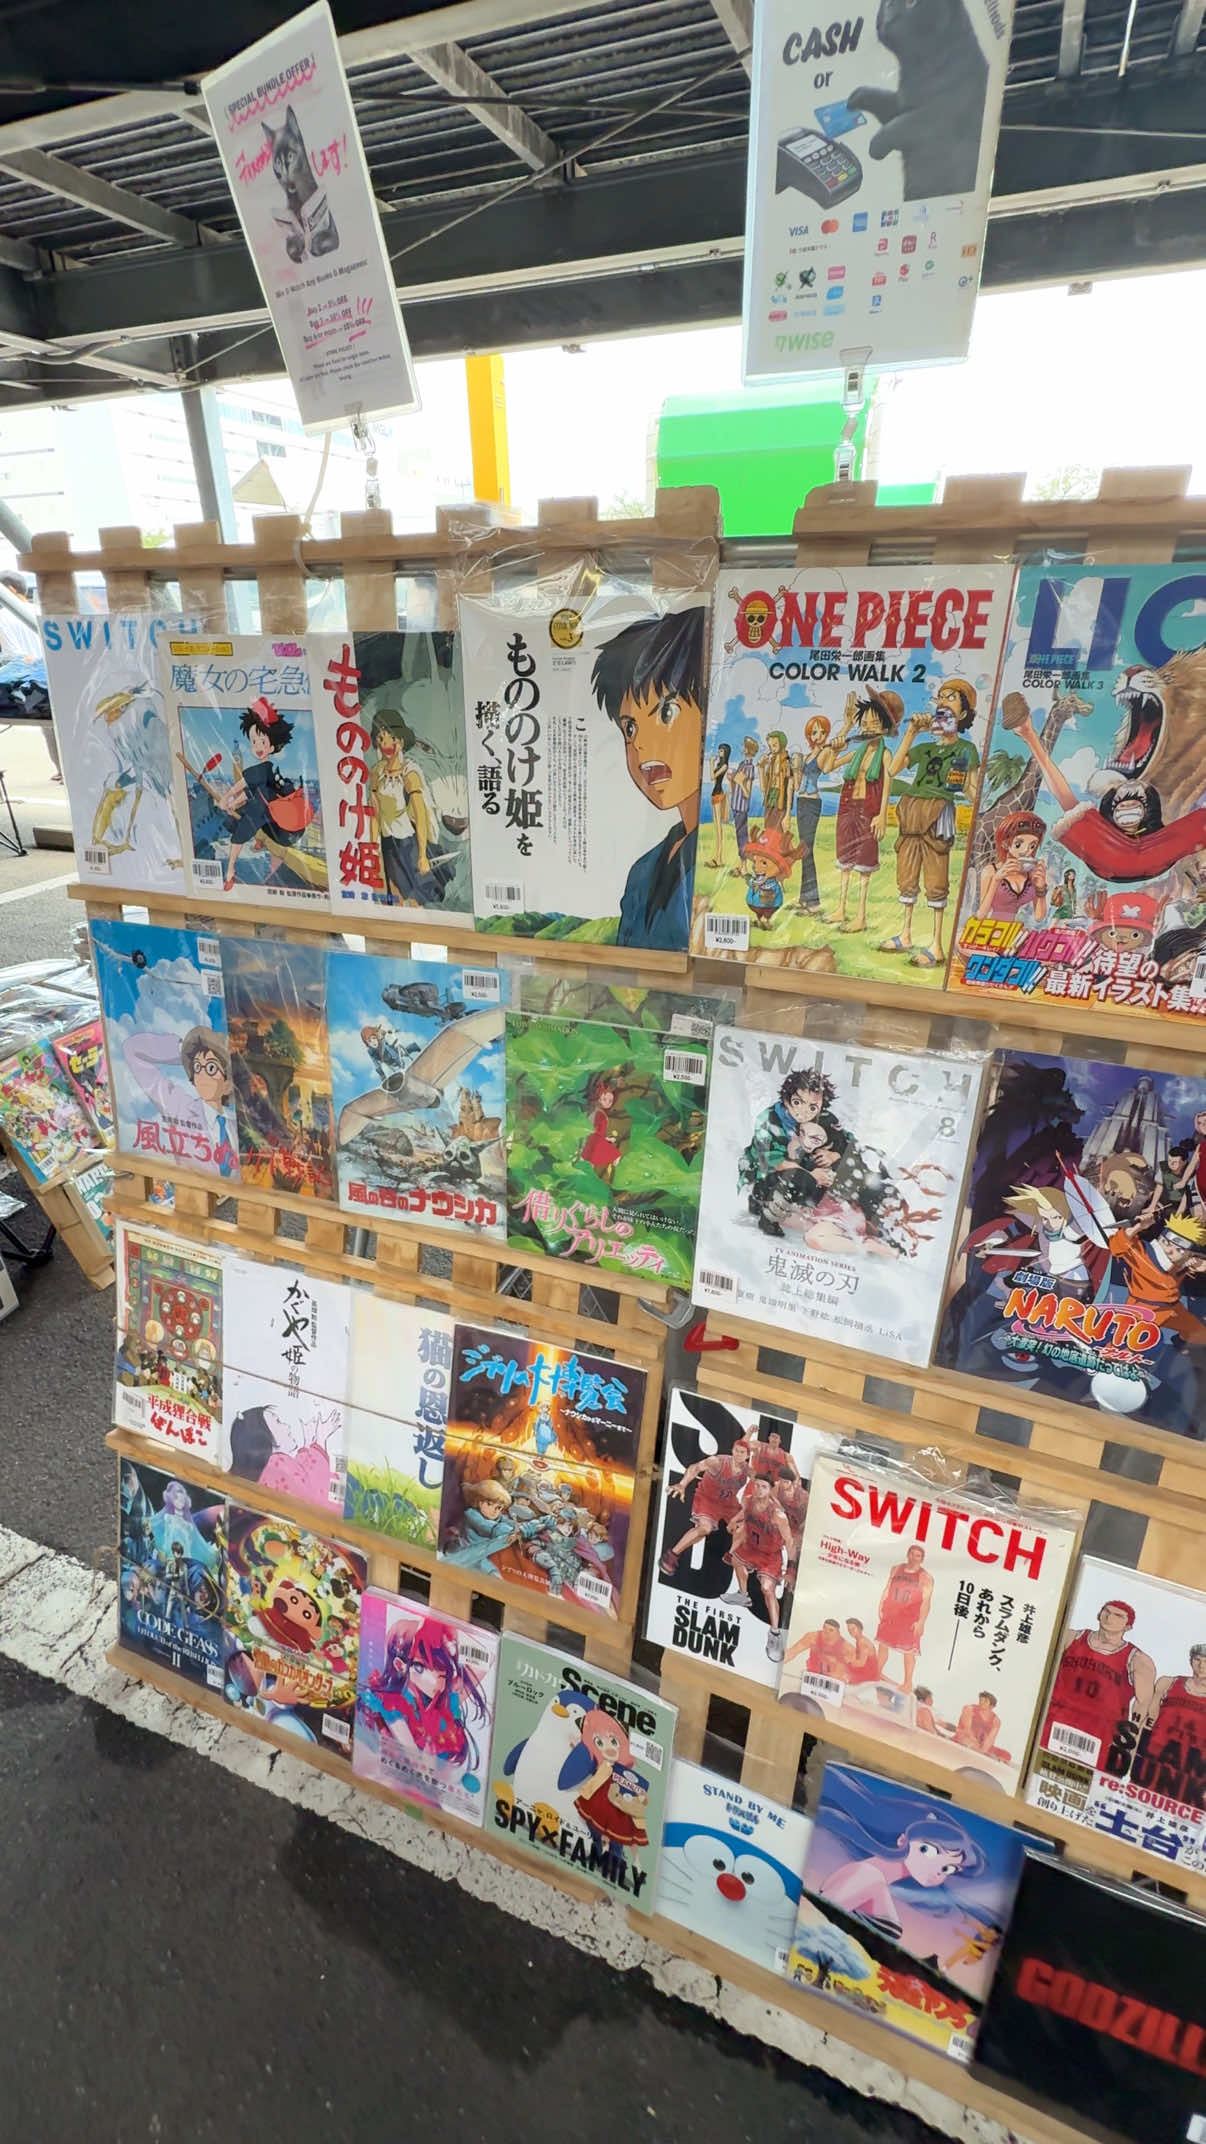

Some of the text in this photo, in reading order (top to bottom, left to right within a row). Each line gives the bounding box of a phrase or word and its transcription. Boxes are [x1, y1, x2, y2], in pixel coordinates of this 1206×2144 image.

[782, 17, 864, 66] CASH
[228, 57, 311, 113] SPECIAL BUNDLE OFFER
[814, 70, 833, 89] or
[789, 226, 809, 237] VISA
[734, 588, 995, 650] ONE PIECE
[170, 664, 311, 696] 魔女の宅急
[769, 662, 926, 683] COLOR WALK 2
[1022, 679, 1104, 690] COLOR WALK 3
[323, 643, 384, 888] もののけ姫
[504, 632, 543, 857] もののけ姫を
[1093, 948, 1160, 978] 待望の
[133, 1119, 240, 1169] 風立ちぬ
[941, 1117, 955, 1137] 8
[348, 1181, 497, 1226] 風の谷のナウシカ
[512, 1188, 635, 1239] 借りぐらしの
[559, 1229, 665, 1274] アリエッティ
[786, 1249, 829, 1265] ANIMATION
[831, 1260, 857, 1272] SERIES
[764, 1254, 861, 1295] 鬼滅の刃
[879, 1327, 903, 1341] LiSA
[1003, 1287, 1161, 1351] NARUTO
[459, 1344, 629, 1415] ジブリの大博覧会
[413, 1328, 453, 1490] 猫の恩返し
[830, 1476, 1048, 1581] SWITCH
[820, 1539, 871, 1565] High-Way
[674, 1604, 741, 1648] SLAM
[676, 1595, 743, 1624] THE FIRST
[973, 1587, 995, 1640] あれから
[1016, 1602, 1037, 1645] 井上雄彦
[137, 1609, 219, 1658] CODE GEASS
[672, 1624, 738, 1668] DUNK
[172, 1651, 181, 1669] II
[507, 1679, 545, 1698] ブルーロック
[562, 1667, 657, 1736] Scene
[703, 1784, 787, 1830] STAND BY ME
[1099, 1775, 1206, 1826] re:SOURCE
